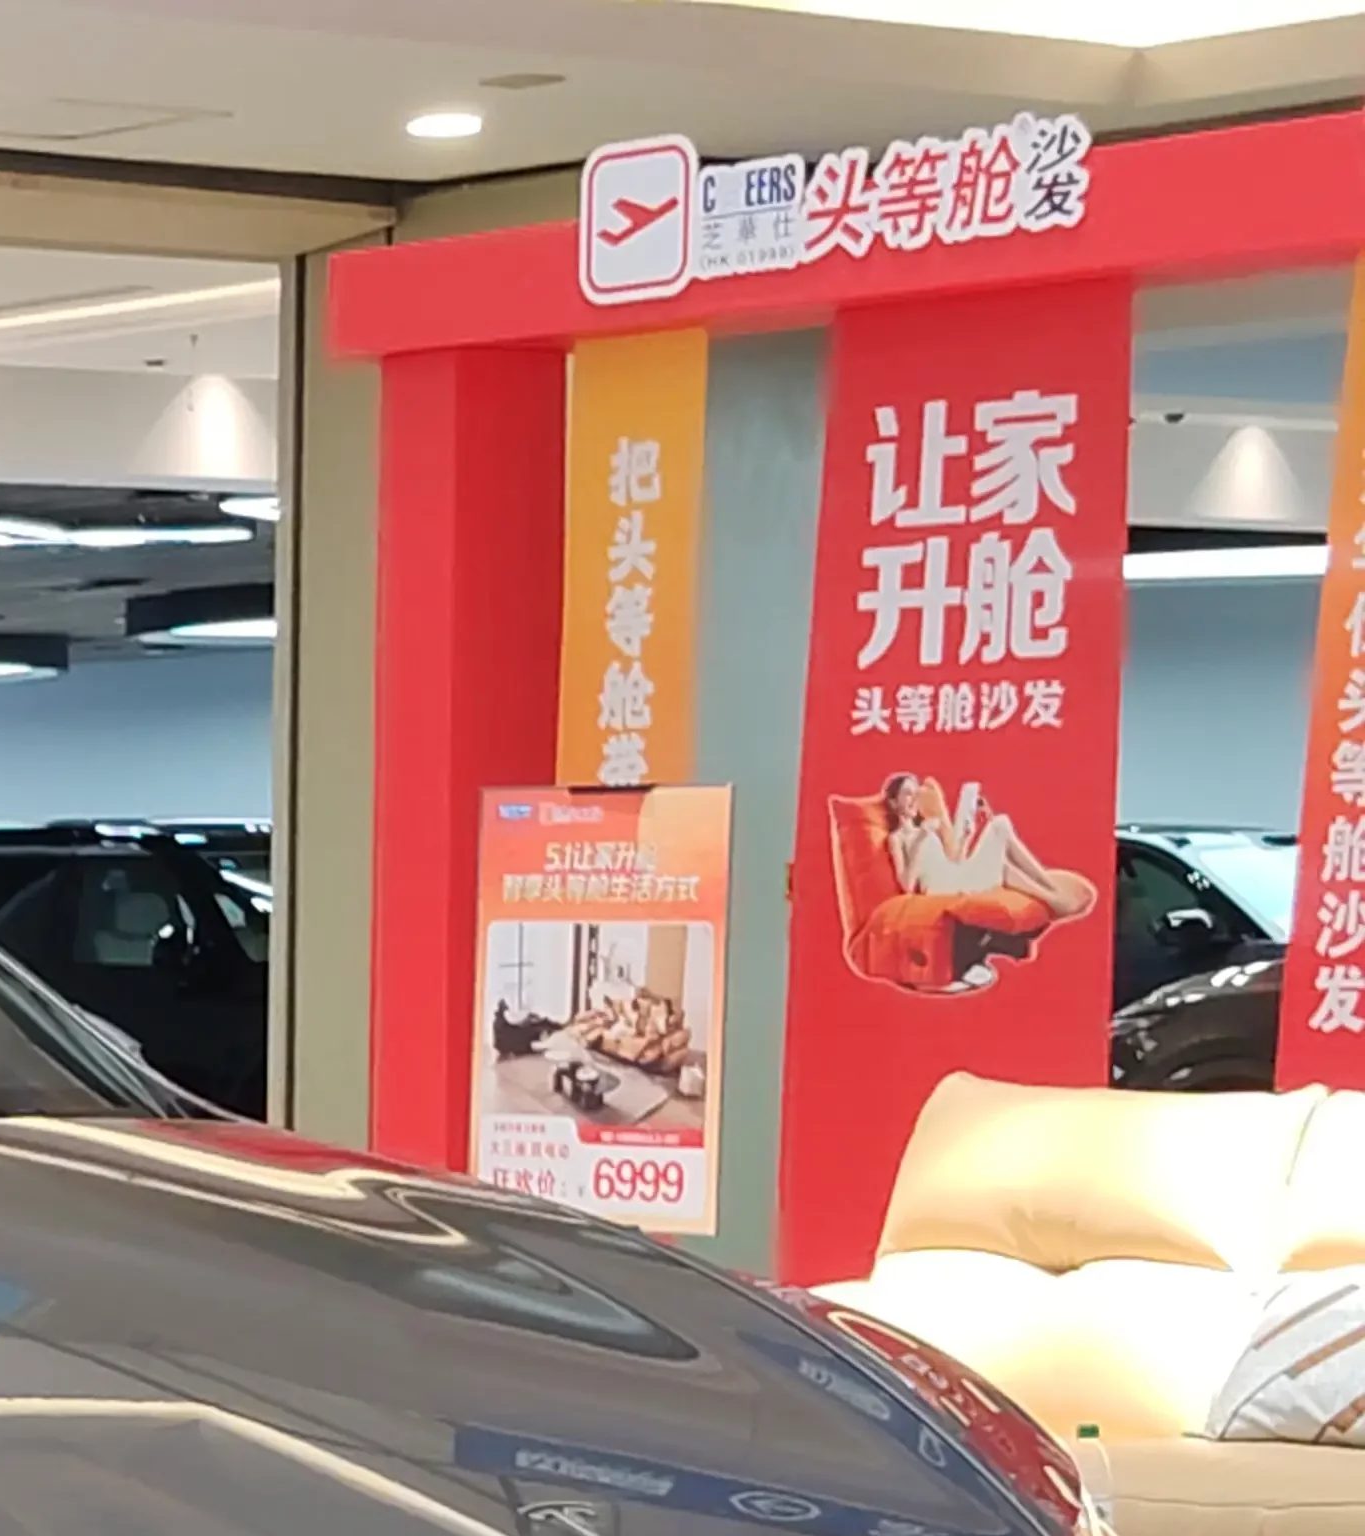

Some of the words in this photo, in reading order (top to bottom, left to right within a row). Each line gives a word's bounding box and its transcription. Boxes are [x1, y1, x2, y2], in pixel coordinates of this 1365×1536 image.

[702, 163, 797, 214] CEERS
[805, 133, 1021, 250] 头等舱
[1025, 124, 1082, 222] 沙发
[866, 390, 1078, 528] 让家
[857, 528, 1073, 670] 升舱
[850, 679, 1066, 735] 头等舱沙发
